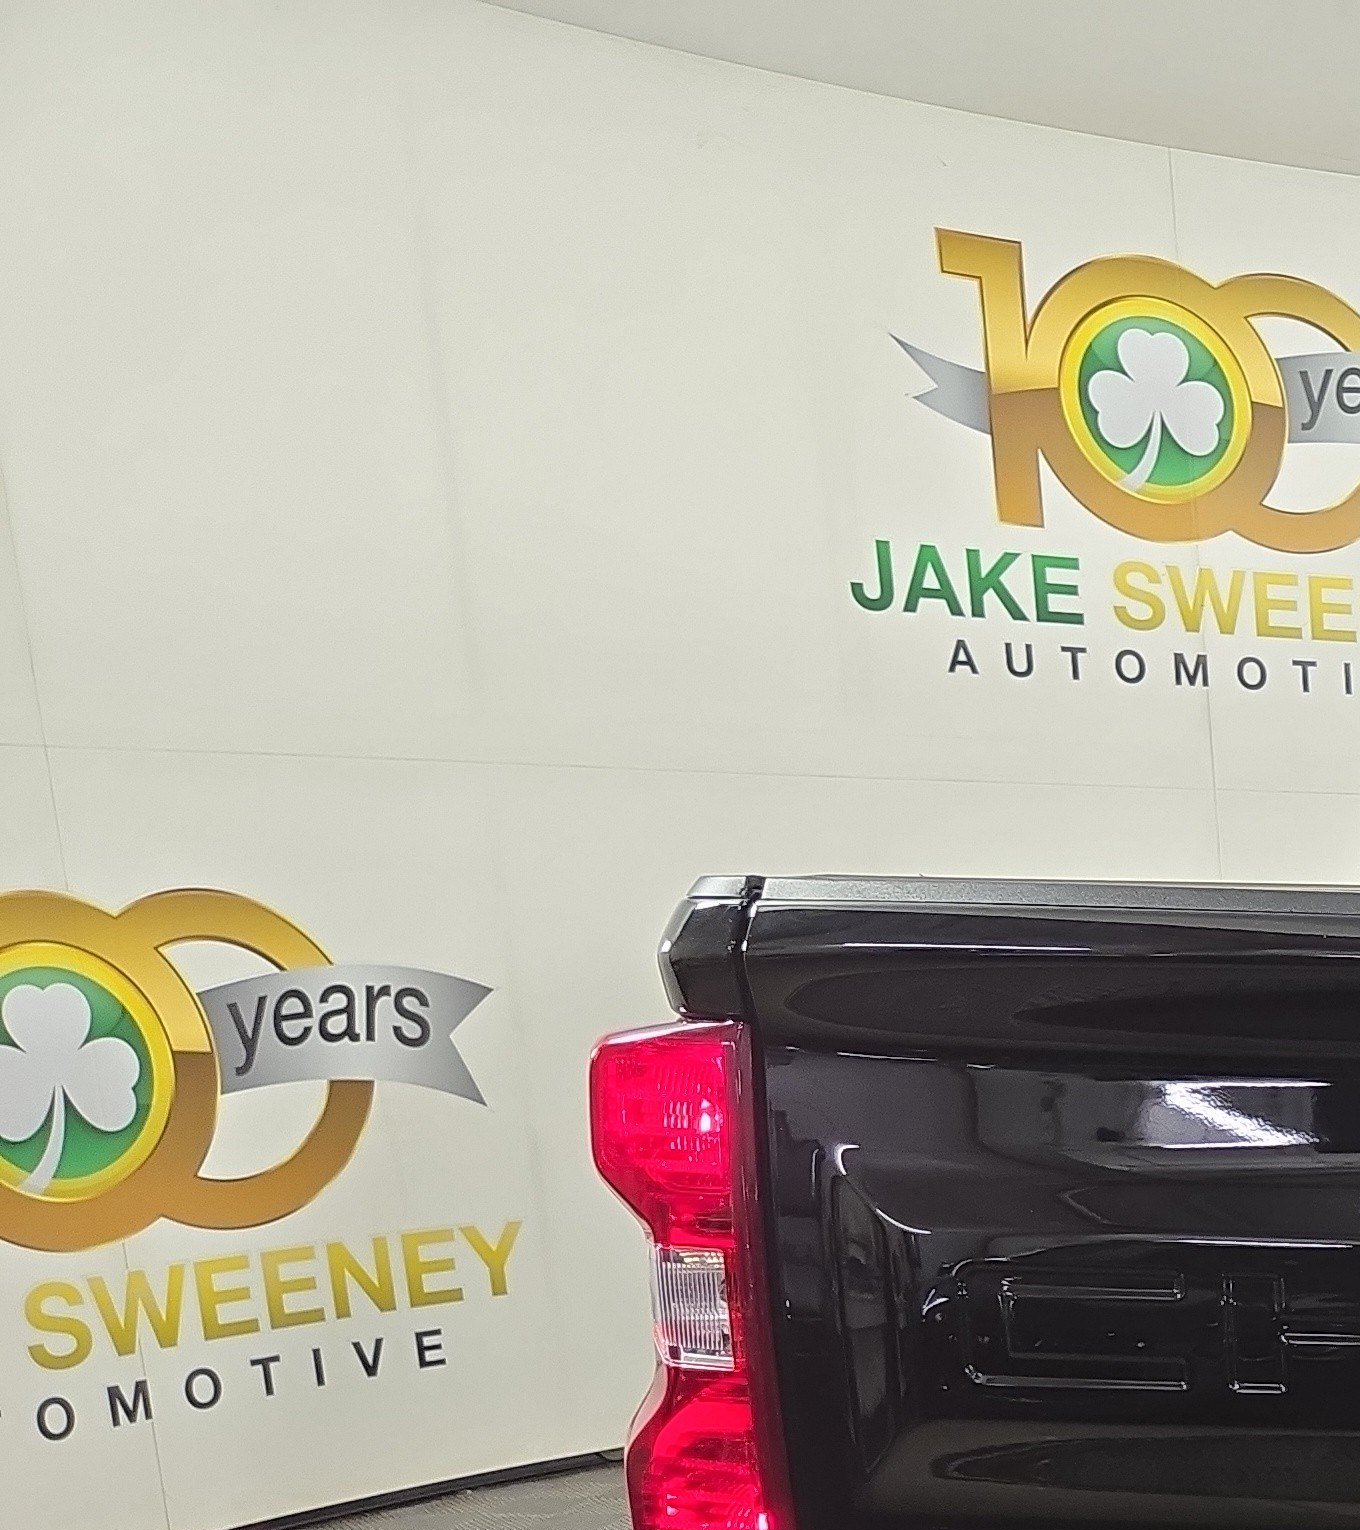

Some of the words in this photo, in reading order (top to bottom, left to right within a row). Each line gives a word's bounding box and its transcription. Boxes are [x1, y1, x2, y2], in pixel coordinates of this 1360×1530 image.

[850, 539, 1085, 627] JAKE
[227, 982, 432, 1077] years
[24, 1220, 523, 1371] SWEENEY
[0, 1328, 447, 1442] OMOTIVE
